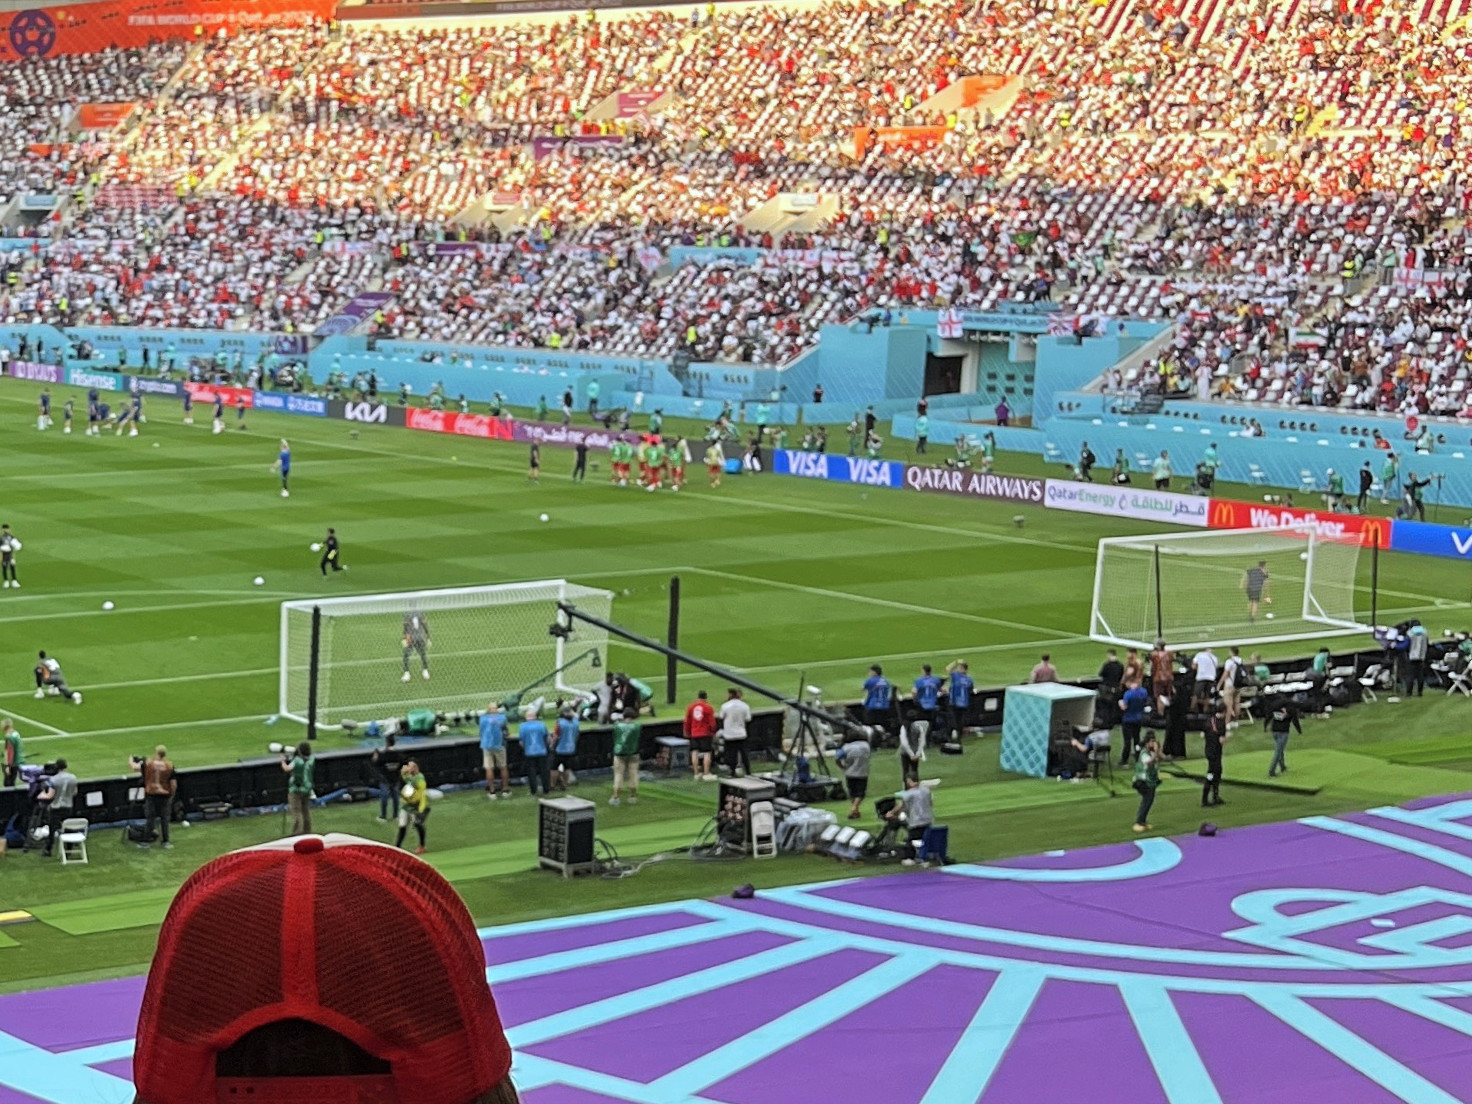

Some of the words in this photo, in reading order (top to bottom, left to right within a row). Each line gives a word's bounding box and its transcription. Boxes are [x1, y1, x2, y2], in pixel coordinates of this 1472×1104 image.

[785, 450, 828, 478] VISA
[846, 456, 891, 486] VISA
[907, 466, 964, 492] QATAR
[968, 472, 1042, 502] AIRWAYS
[1047, 485, 1115, 507] QatarEnergy
[1250, 507, 1277, 528] We
[1280, 511, 1345, 538] Deliver
